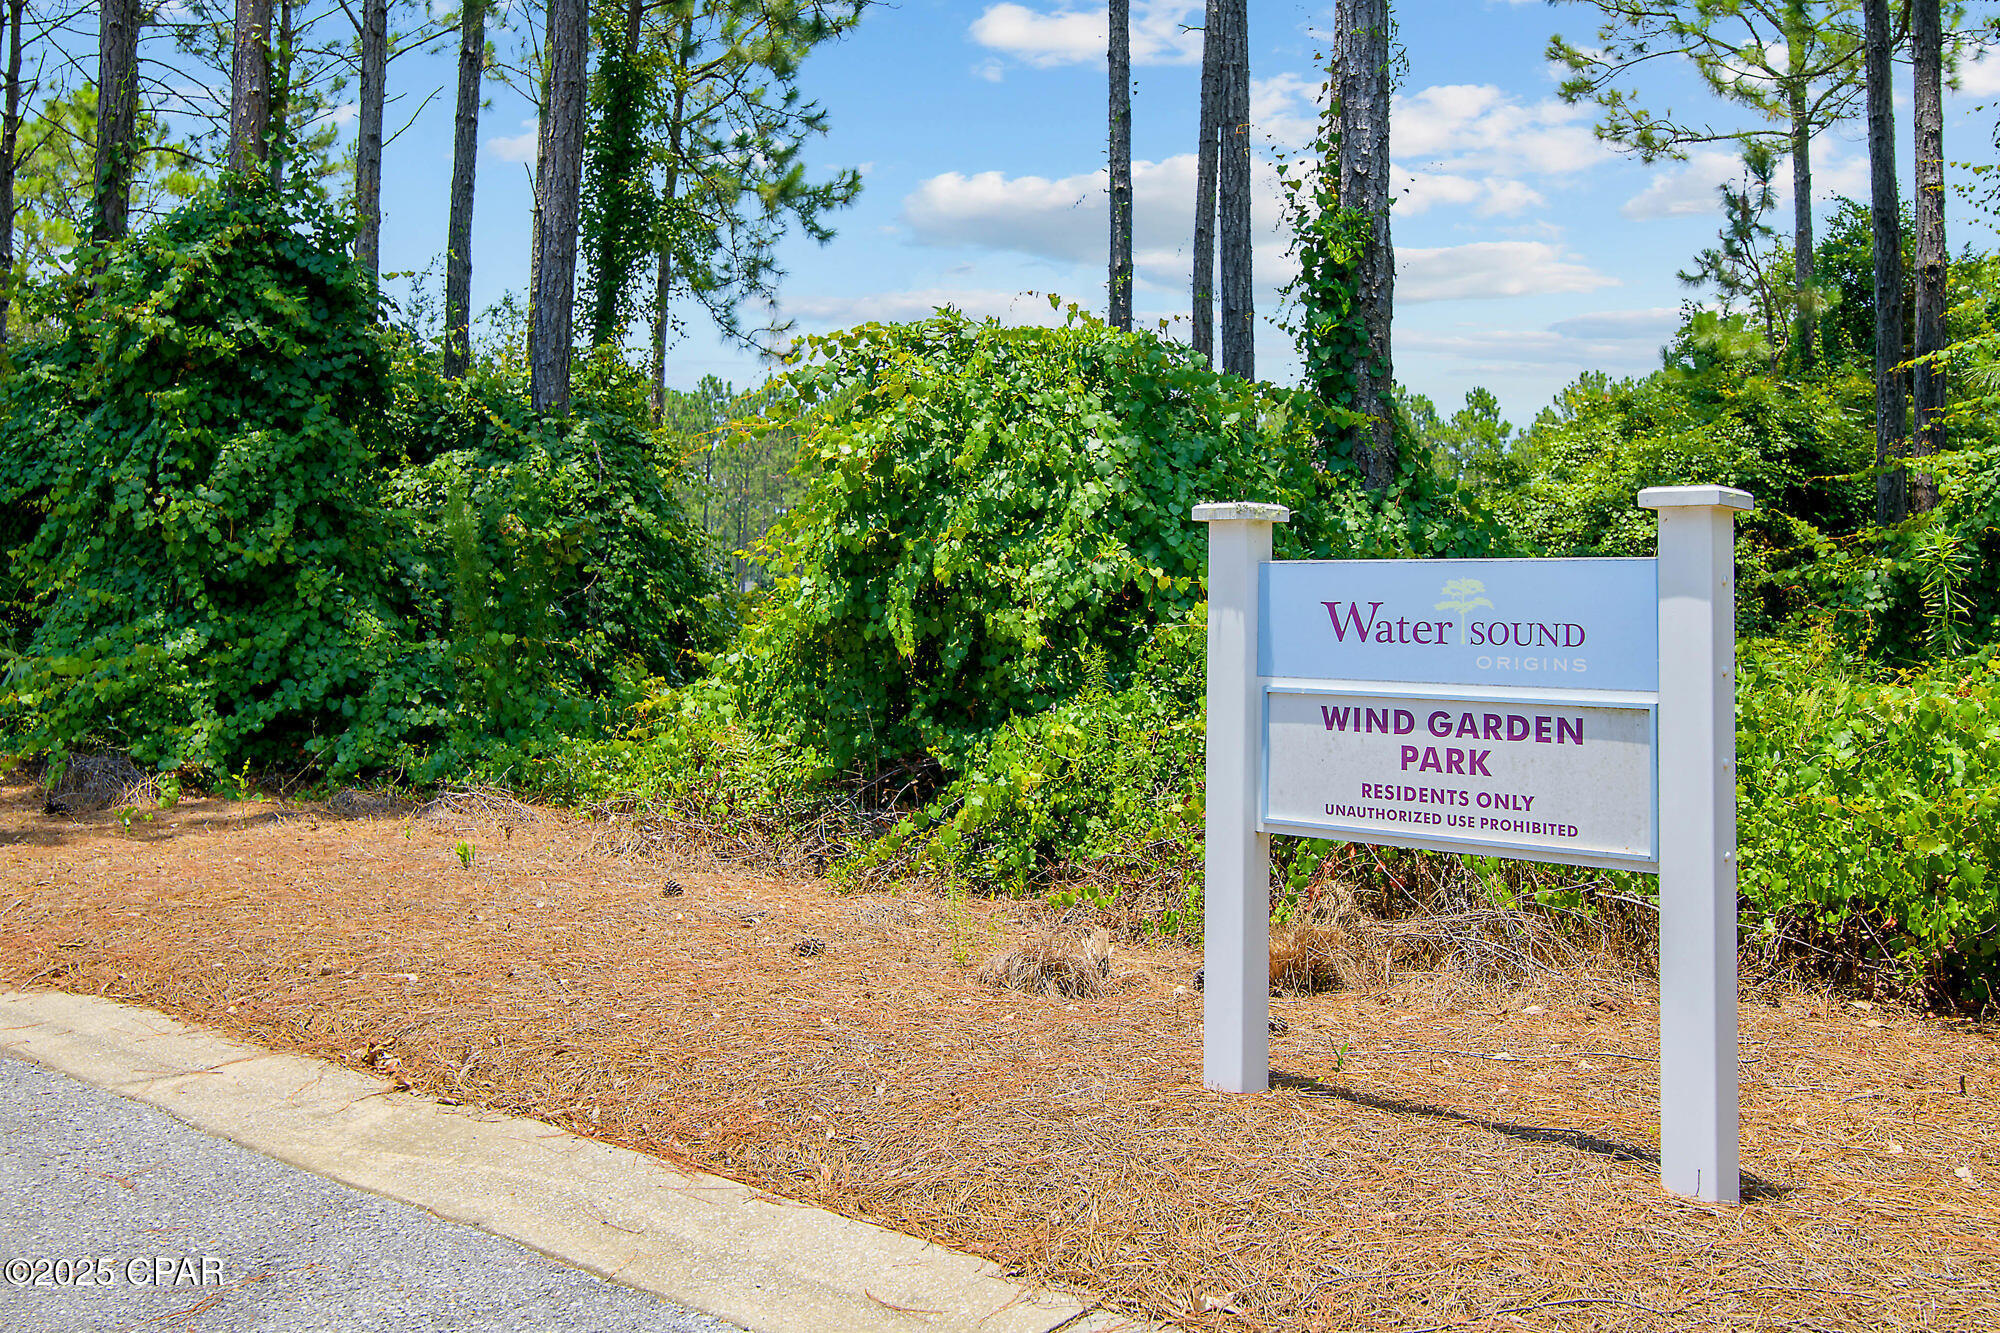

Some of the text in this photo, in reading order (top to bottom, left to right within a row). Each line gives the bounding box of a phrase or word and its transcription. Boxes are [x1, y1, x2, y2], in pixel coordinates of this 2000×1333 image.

[1321, 601, 1586, 648] Water SOUND
[1476, 656, 1588, 673] ORIGINS
[1321, 706, 1584, 745] WIND GARDEN
[1400, 745, 1492, 777] PARK
[1361, 783, 1535, 812] RESIDENTS ONLY
[1325, 803, 1579, 838] UNAUTHORIZED USE PROHIBITED
